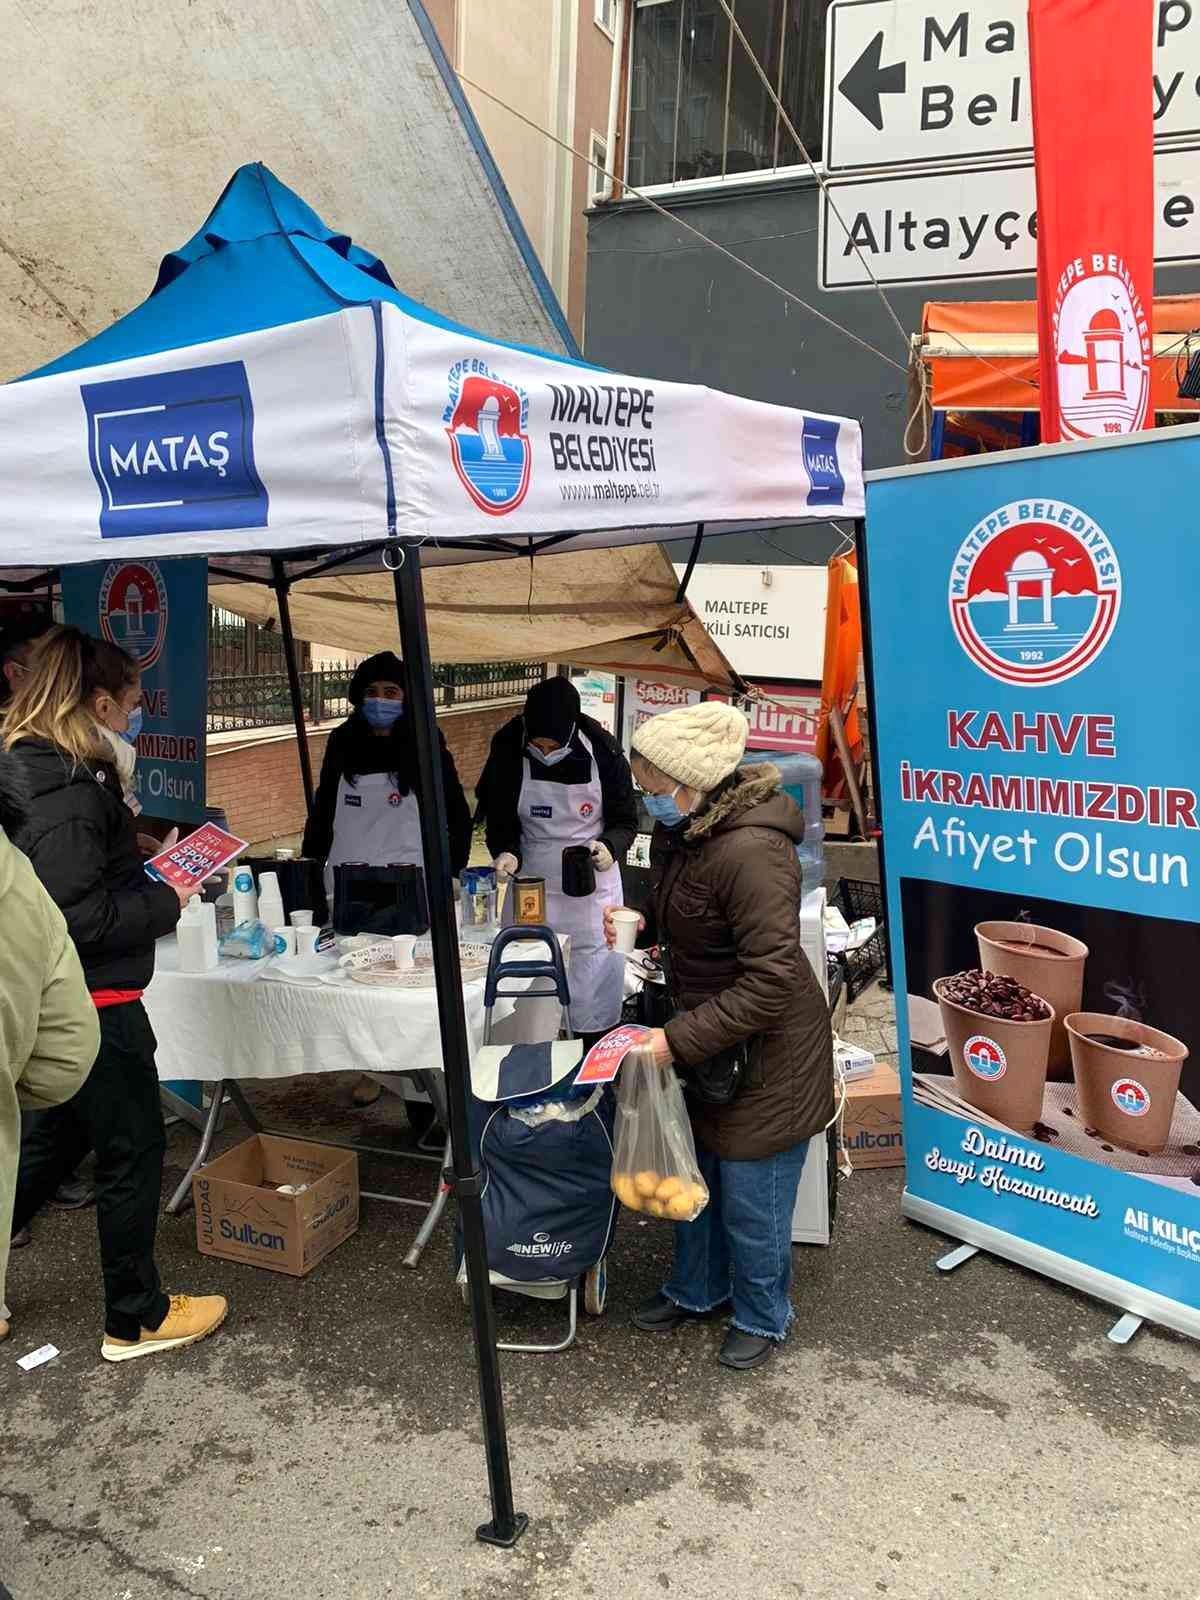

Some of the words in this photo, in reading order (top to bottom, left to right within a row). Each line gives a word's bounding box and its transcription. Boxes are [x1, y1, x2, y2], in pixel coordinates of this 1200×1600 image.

[545, 384, 656, 430] MALTEPE
[109, 431, 230, 477] MATAŞ
[951, 510, 1010, 594] MALTEPE
[1018, 503, 1117, 586] BELEDİYESİ
[704, 600, 769, 615] MALTEPE
[733, 623, 790, 640] SATICISI
[1019, 651, 1044, 661] 1992
[946, 709, 1117, 759] KAHVE
[148, 768, 195, 801] Olsun
[900, 760, 1200, 830] İKRAMIMIZDIR
[180, 845, 215, 869] SPORA
[913, 816, 1038, 871] Afiyet
[1054, 832, 1189, 888] Olsun
[961, 1127, 1045, 1173] Daima
[979, 1164, 1100, 1219] Kazanacak
[220, 1217, 286, 1251] Sultan
[1124, 1207, 1150, 1233] Ali
